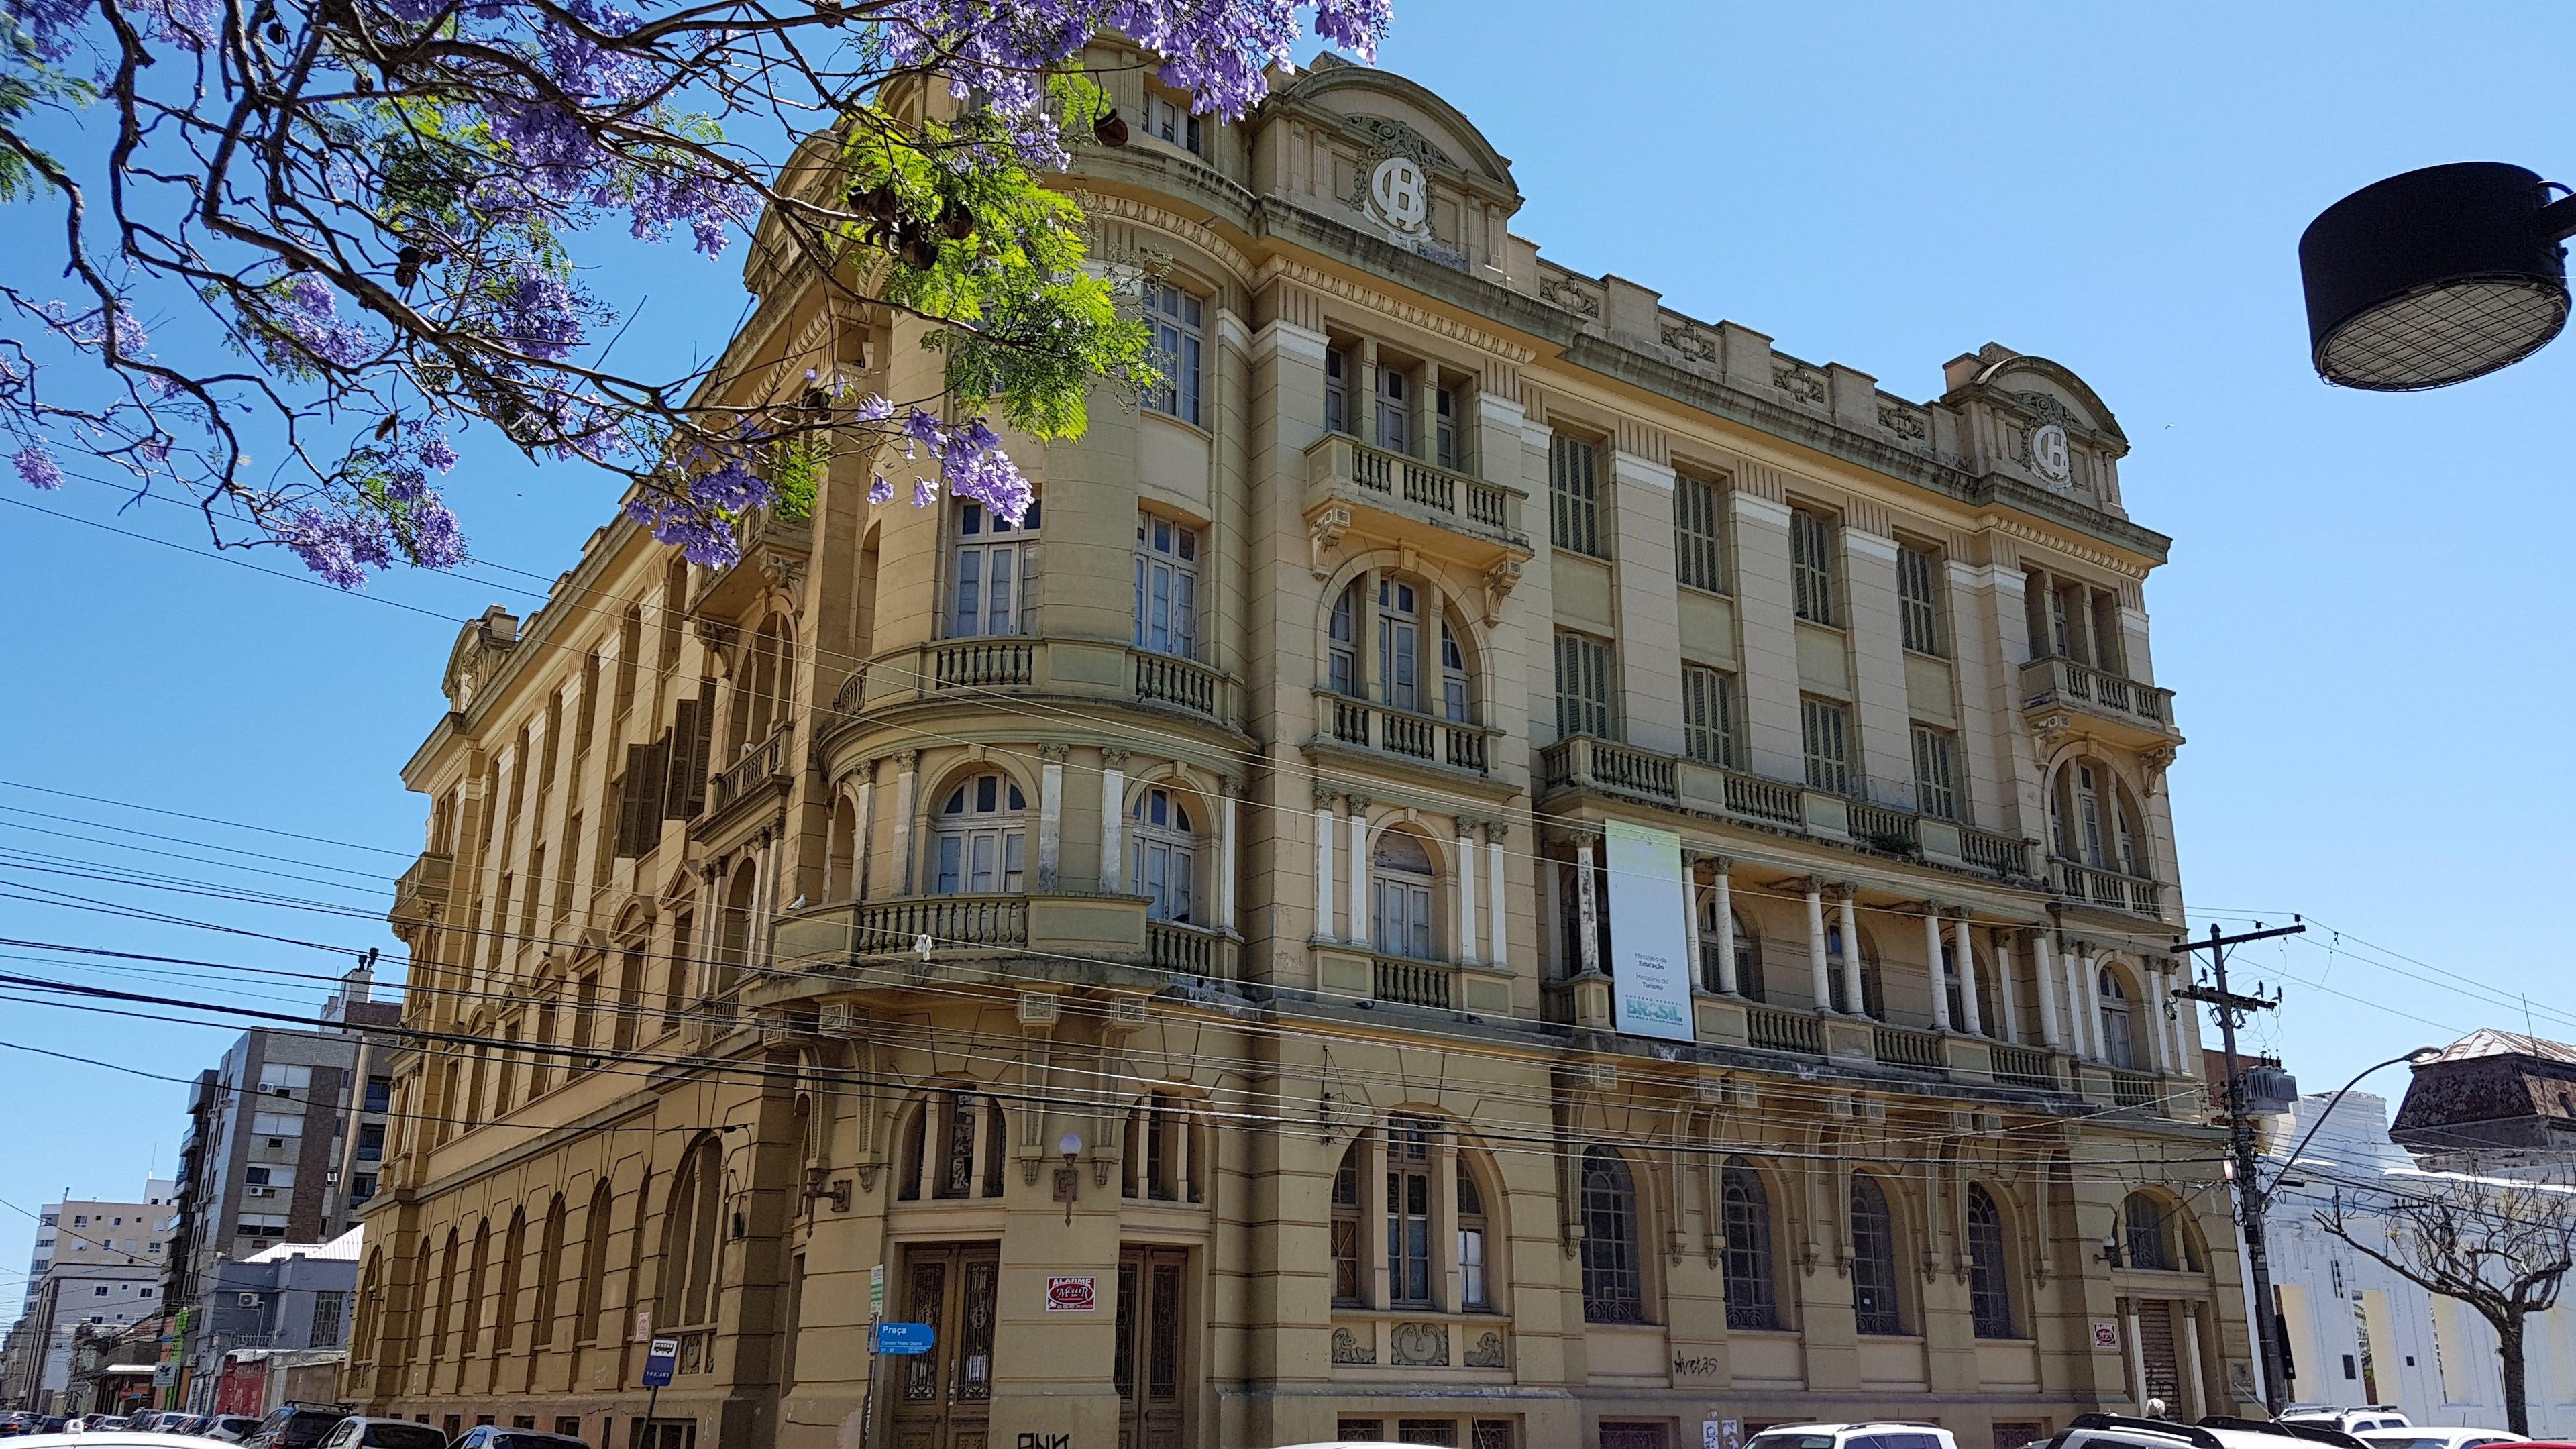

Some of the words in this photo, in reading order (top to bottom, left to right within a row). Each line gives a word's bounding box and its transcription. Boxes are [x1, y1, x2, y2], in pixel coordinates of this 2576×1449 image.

[1638, 960, 1664, 970] Educação
[1642, 981, 1664, 991] Turismo
[1626, 998, 1683, 1022] BRASIL
[1052, 1277, 1091, 1287] ALARME
[882, 1325, 907, 1336] Praça
